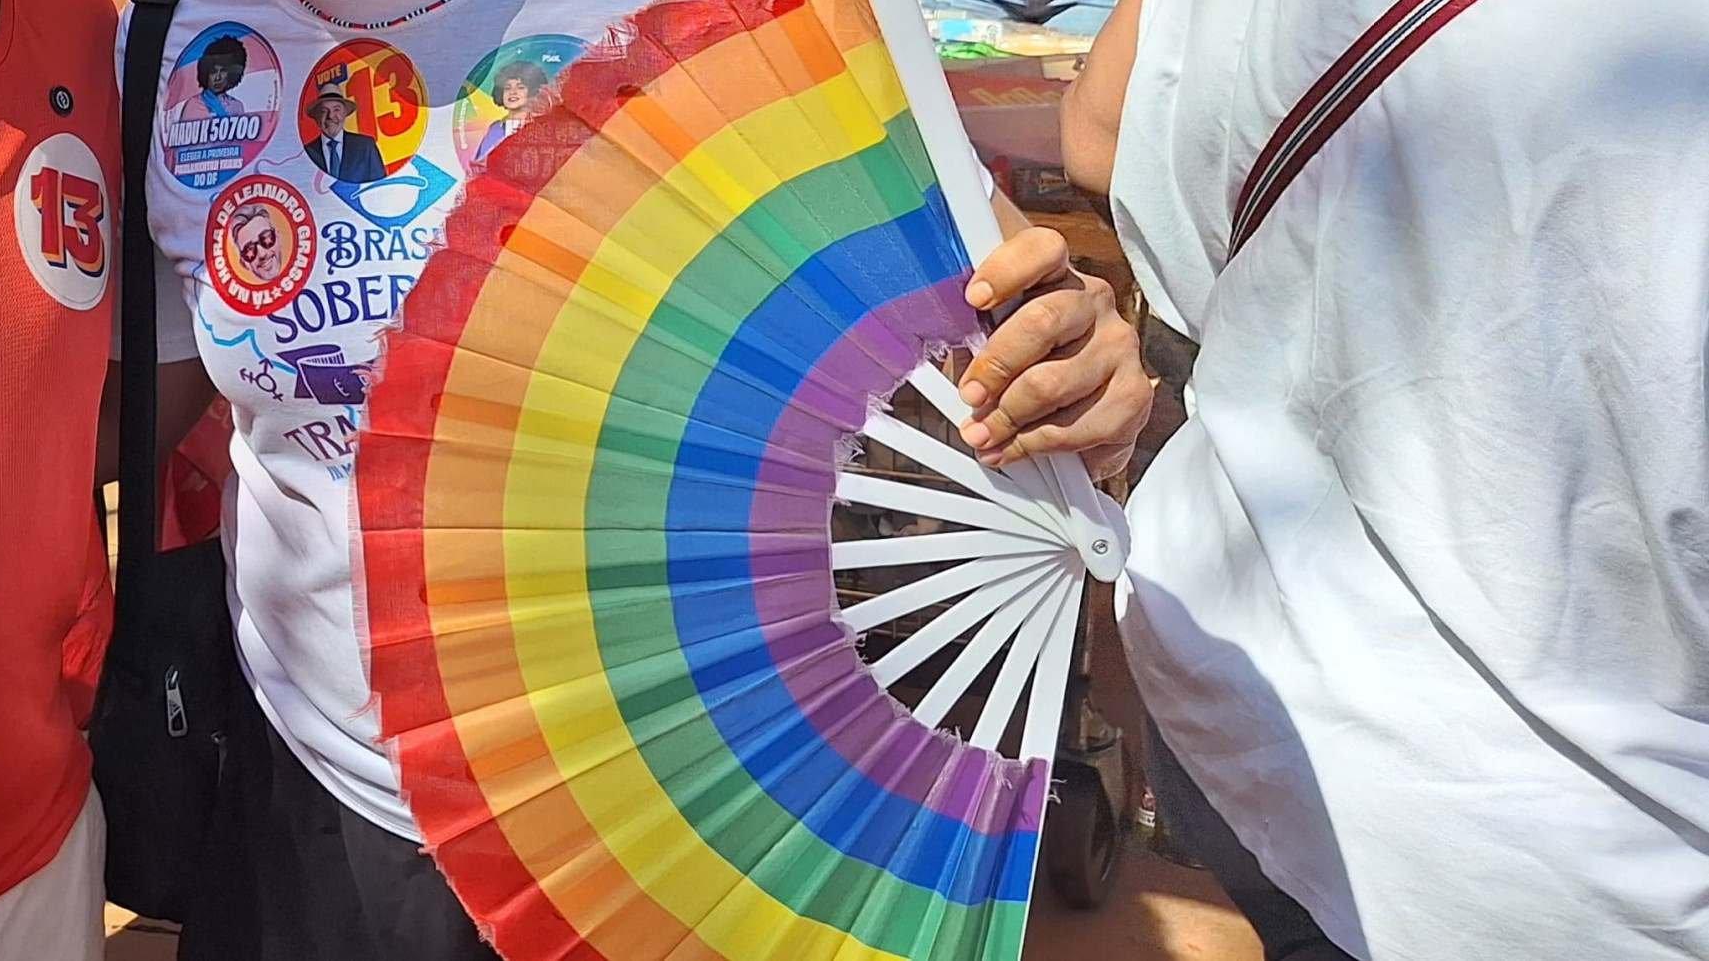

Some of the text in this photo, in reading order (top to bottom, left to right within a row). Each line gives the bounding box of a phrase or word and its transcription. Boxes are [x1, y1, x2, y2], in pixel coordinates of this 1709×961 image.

[316, 64, 342, 85] VOTE
[345, 54, 420, 142] 13
[209, 116, 261, 142] 50700
[30, 166, 104, 273] 13
[217, 200, 236, 227] DE
[233, 182, 306, 223] LEANDRO
[213, 227, 232, 284] HORA
[279, 225, 311, 293] GRASS
[321, 220, 428, 275] BRAS
[228, 278, 250, 304] NA
[266, 275, 417, 344] SOBER
[284, 414, 358, 462] TRA
